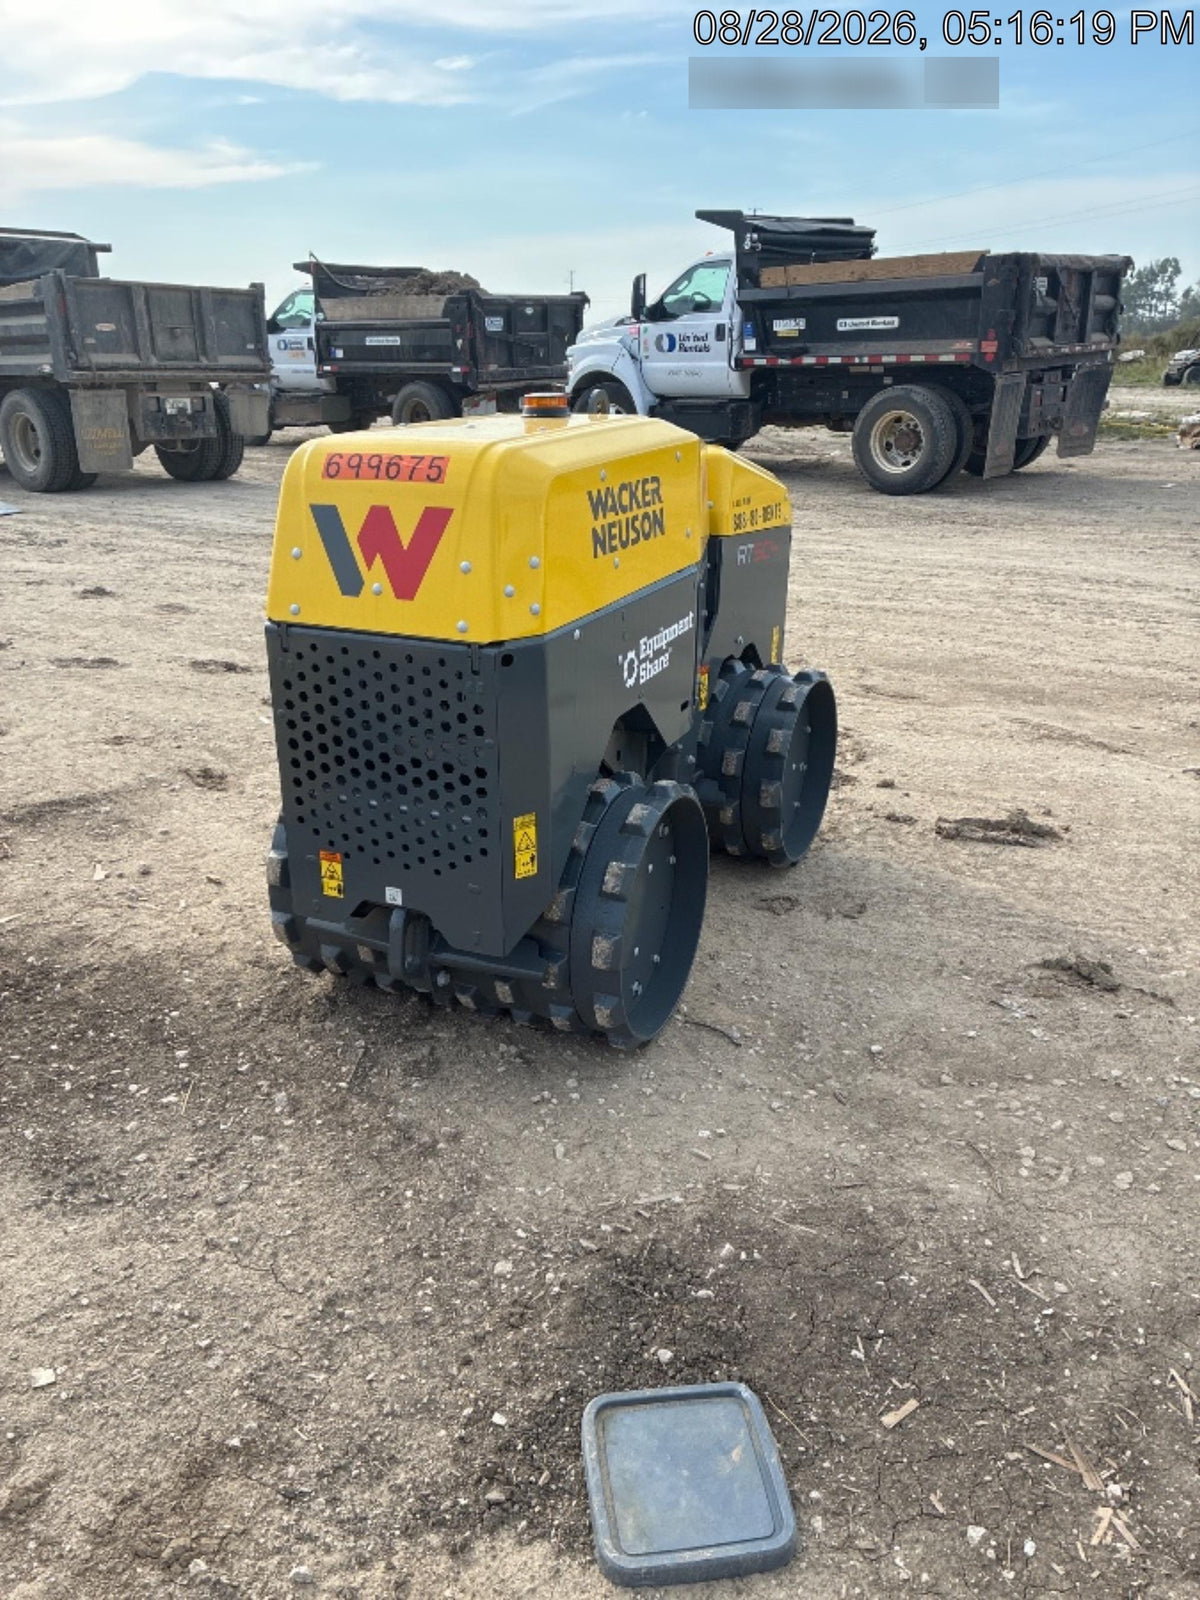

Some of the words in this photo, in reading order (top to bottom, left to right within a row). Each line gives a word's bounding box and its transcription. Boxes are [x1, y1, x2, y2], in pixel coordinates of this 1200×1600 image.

[325, 453, 445, 482] 699675
[586, 475, 663, 521] WACKER
[591, 506, 665, 559] NEUSON
[639, 610, 694, 660] Equipment
[639, 650, 670, 685] Share
